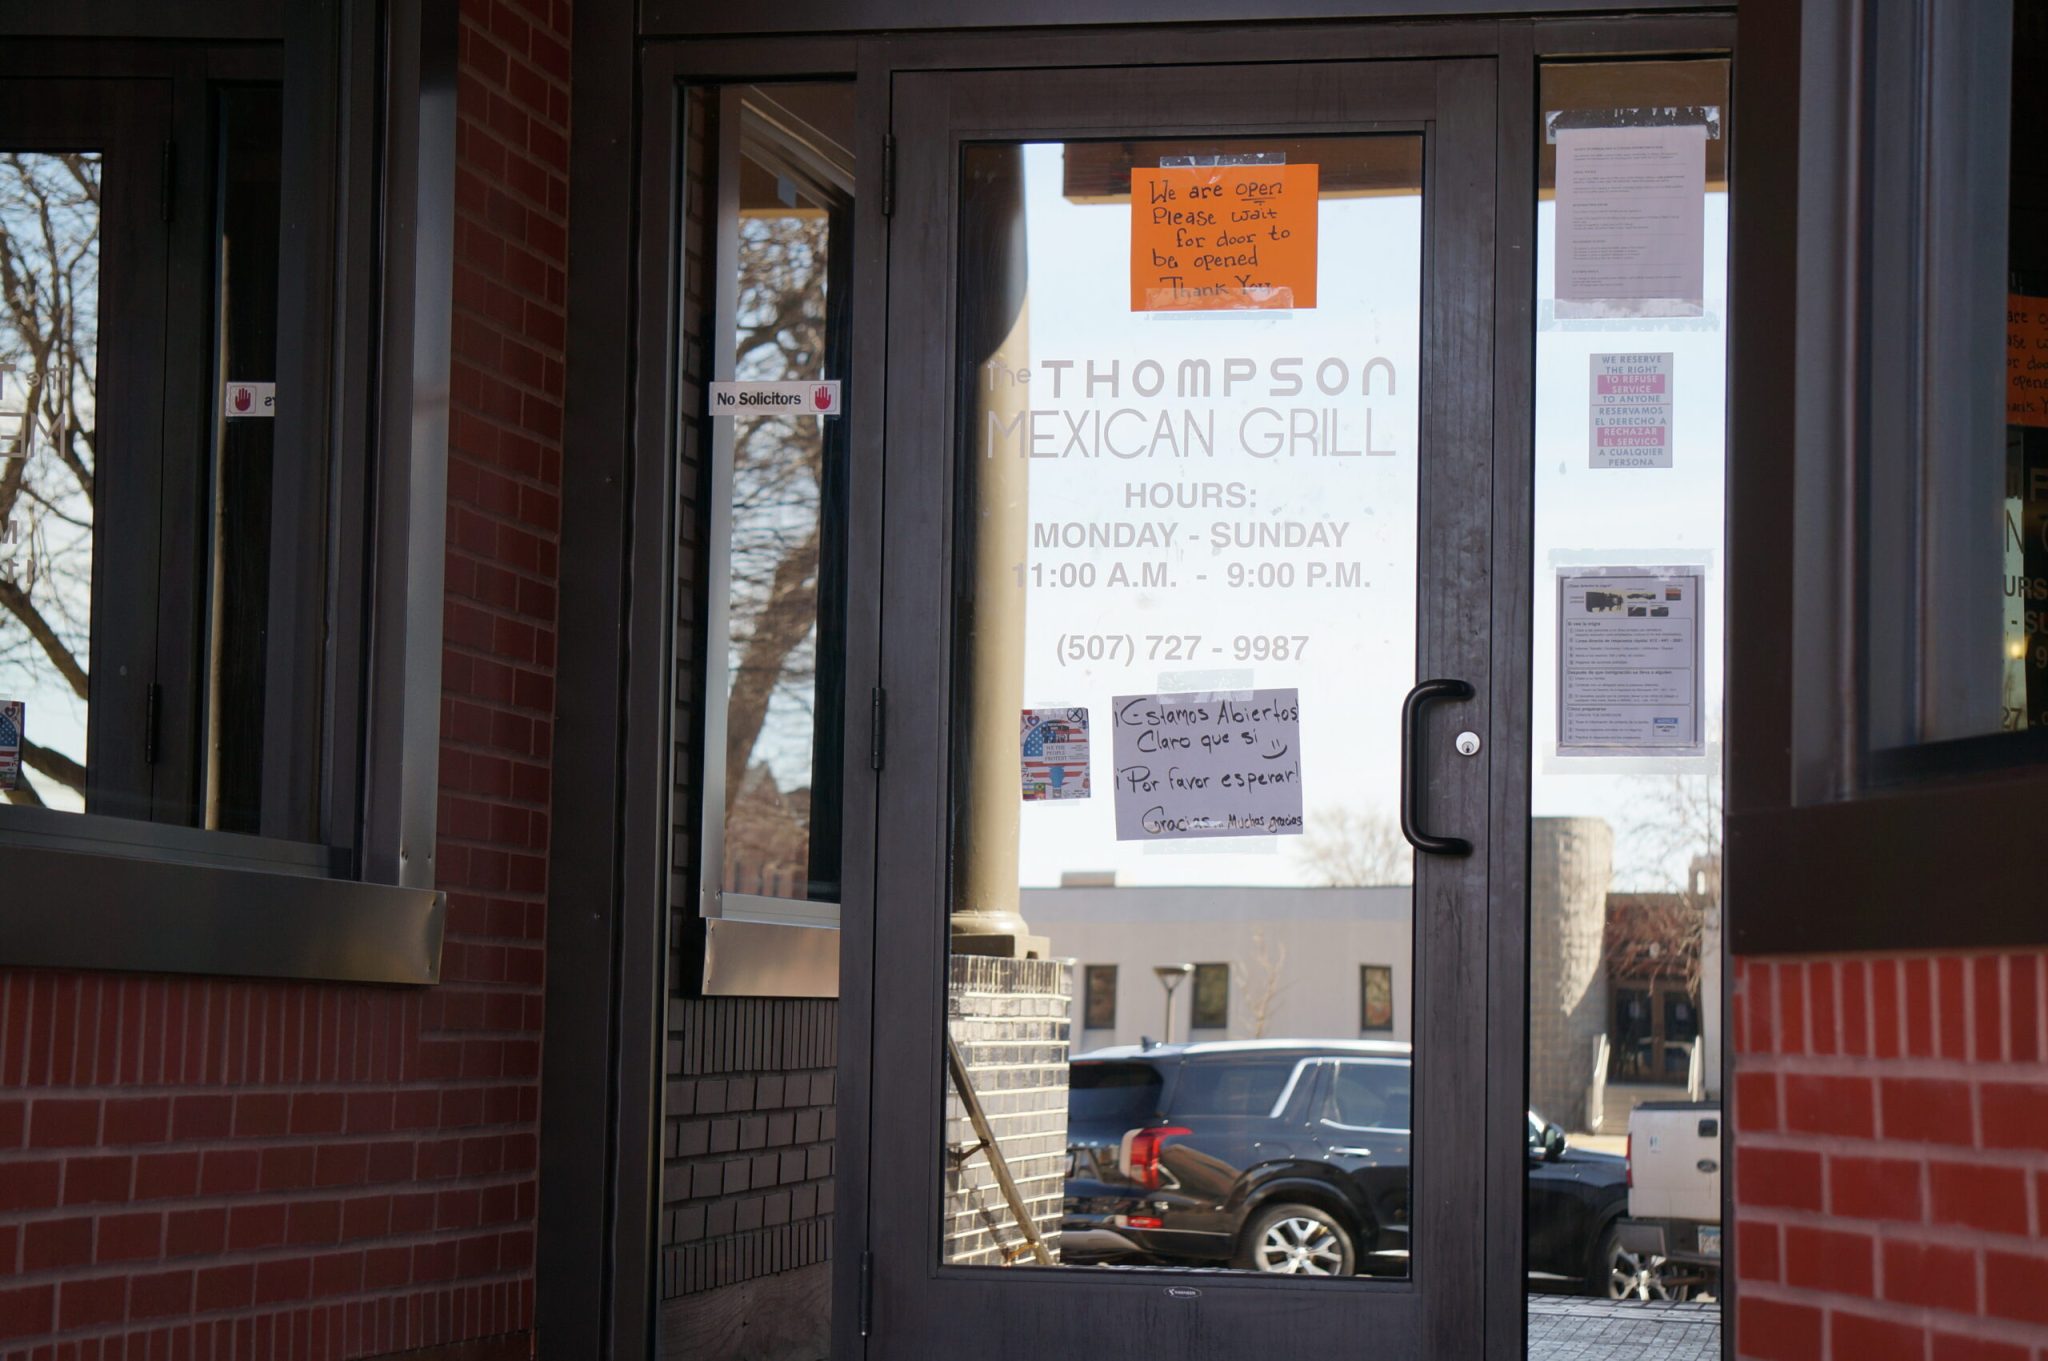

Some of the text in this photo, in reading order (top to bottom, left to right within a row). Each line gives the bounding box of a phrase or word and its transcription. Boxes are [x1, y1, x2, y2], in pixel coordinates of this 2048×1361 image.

[1150, 180, 1282, 204] We are open
[1153, 204, 1277, 225] Please wait
[1176, 225, 1290, 247] for door to
[1152, 245, 1258, 270] be opened
[1160, 274, 1271, 300] Thank You
[1602, 355, 1662, 364] WE RESERVE
[1627, 366, 1658, 374] RIGHT
[1041, 357, 1397, 398] THOMPSON
[1622, 375, 1657, 383] REFUSE
[717, 391, 801, 406] No Solicitors
[1612, 385, 1652, 394] SERVICE
[1620, 395, 1661, 403] ANYONE
[1600, 406, 1664, 415] RESERVAMOS
[1595, 417, 1667, 426] EL DERECHO A
[1604, 427, 1657, 436] RECHAZAR
[987, 407, 1397, 459] MEXICAN GRILL
[1603, 438, 1615, 446] EL
[1609, 458, 1655, 467] PERSONA
[1610, 448, 1664, 457] CUALQUIER
[1125, 481, 1257, 509] HOURS:
[1034, 522, 1178, 548] MONDAY
[1210, 521, 1350, 548] SUNDAY
[1012, 562, 1096, 588] 11:00
[1107, 562, 1177, 588] A.M.
[1227, 562, 1295, 588] 9:00
[1306, 562, 1371, 588] P.M.
[1057, 634, 1135, 667] (507)
[1146, 635, 1202, 660] 727
[1233, 635, 1309, 661] 9987
[1137, 730, 1191, 752] Claro
[1201, 733, 1229, 754] que
[1168, 767, 1210, 790] favor
